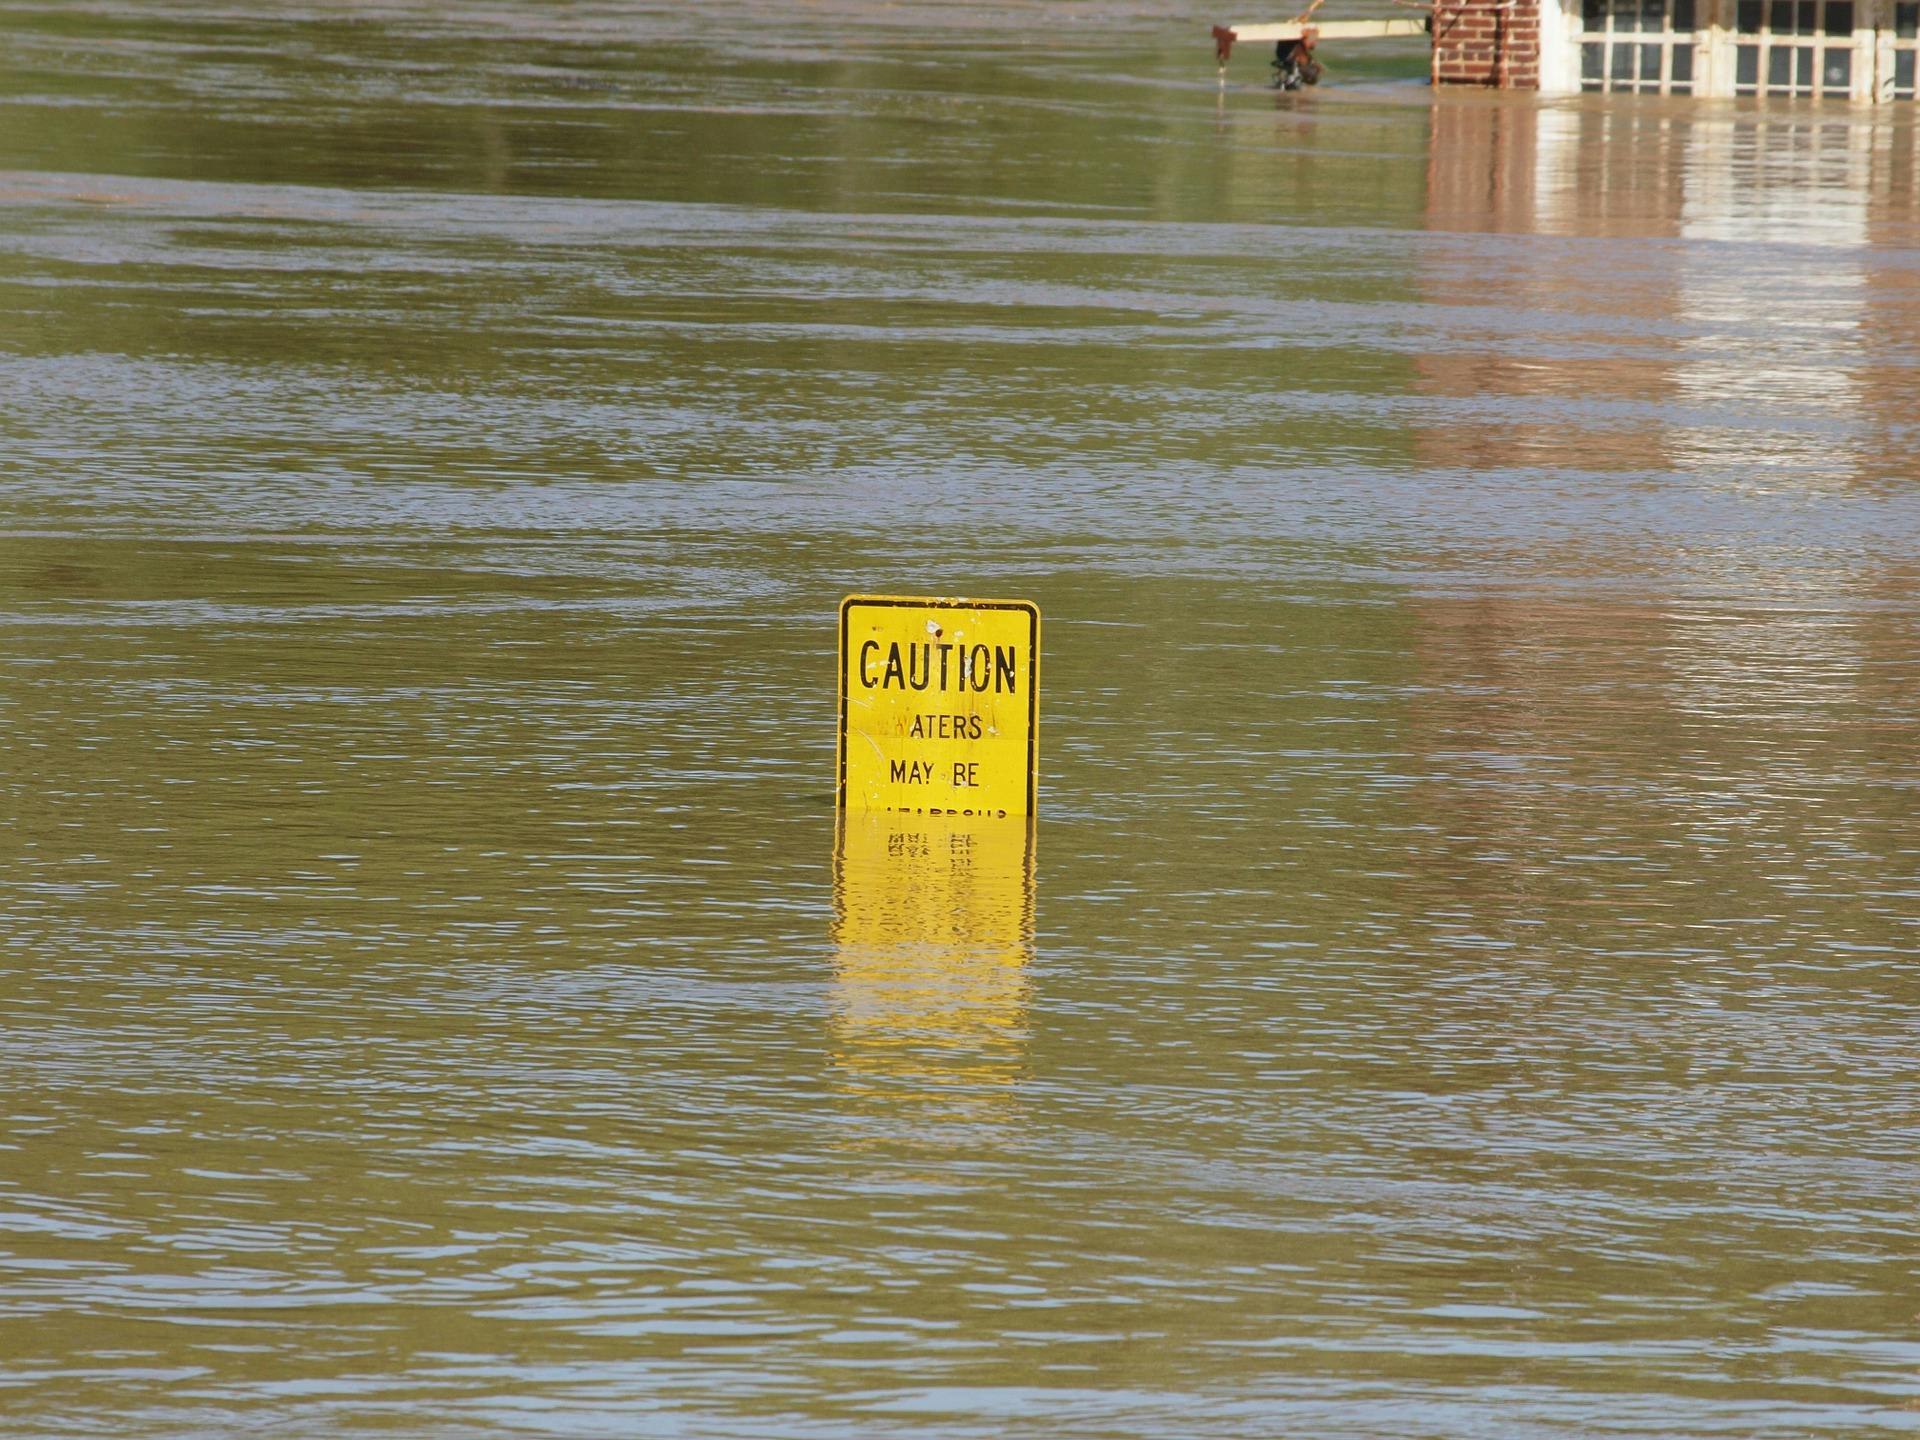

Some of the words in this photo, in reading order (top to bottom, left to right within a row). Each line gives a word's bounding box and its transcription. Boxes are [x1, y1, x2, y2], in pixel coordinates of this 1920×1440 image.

[860, 640, 1016, 694] CAUTION
[896, 714, 982, 740] ATERS
[890, 759, 934, 785] MAY
[953, 762, 979, 787] BE
